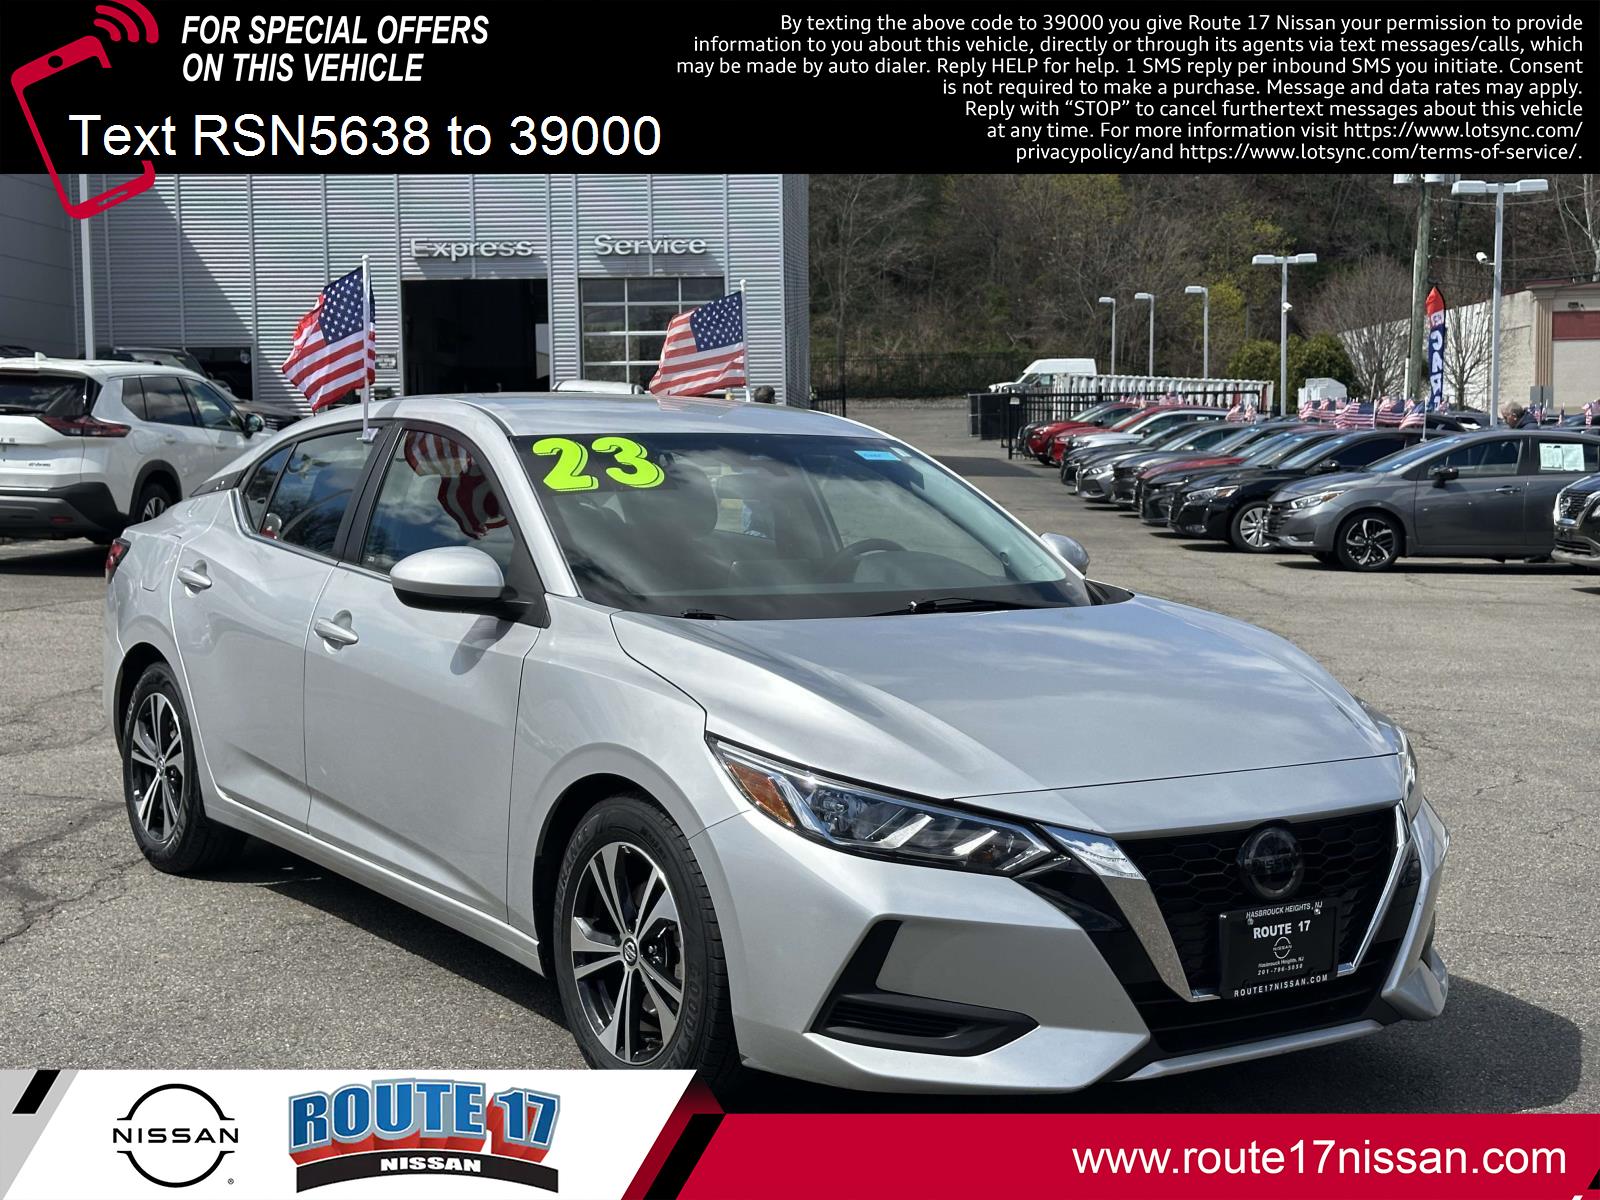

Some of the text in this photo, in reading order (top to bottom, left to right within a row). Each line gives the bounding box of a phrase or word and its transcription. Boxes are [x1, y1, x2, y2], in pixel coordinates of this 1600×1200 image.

[410, 234, 707, 261] Express Service
[533, 436, 665, 492] 23
[1246, 907, 1284, 918] HASBROUCK
[1314, 901, 1323, 909] NJ
[1253, 920, 1311, 939] ROUTE 17
[1234, 974, 1328, 998] ROUTE17NISSAN.COM
